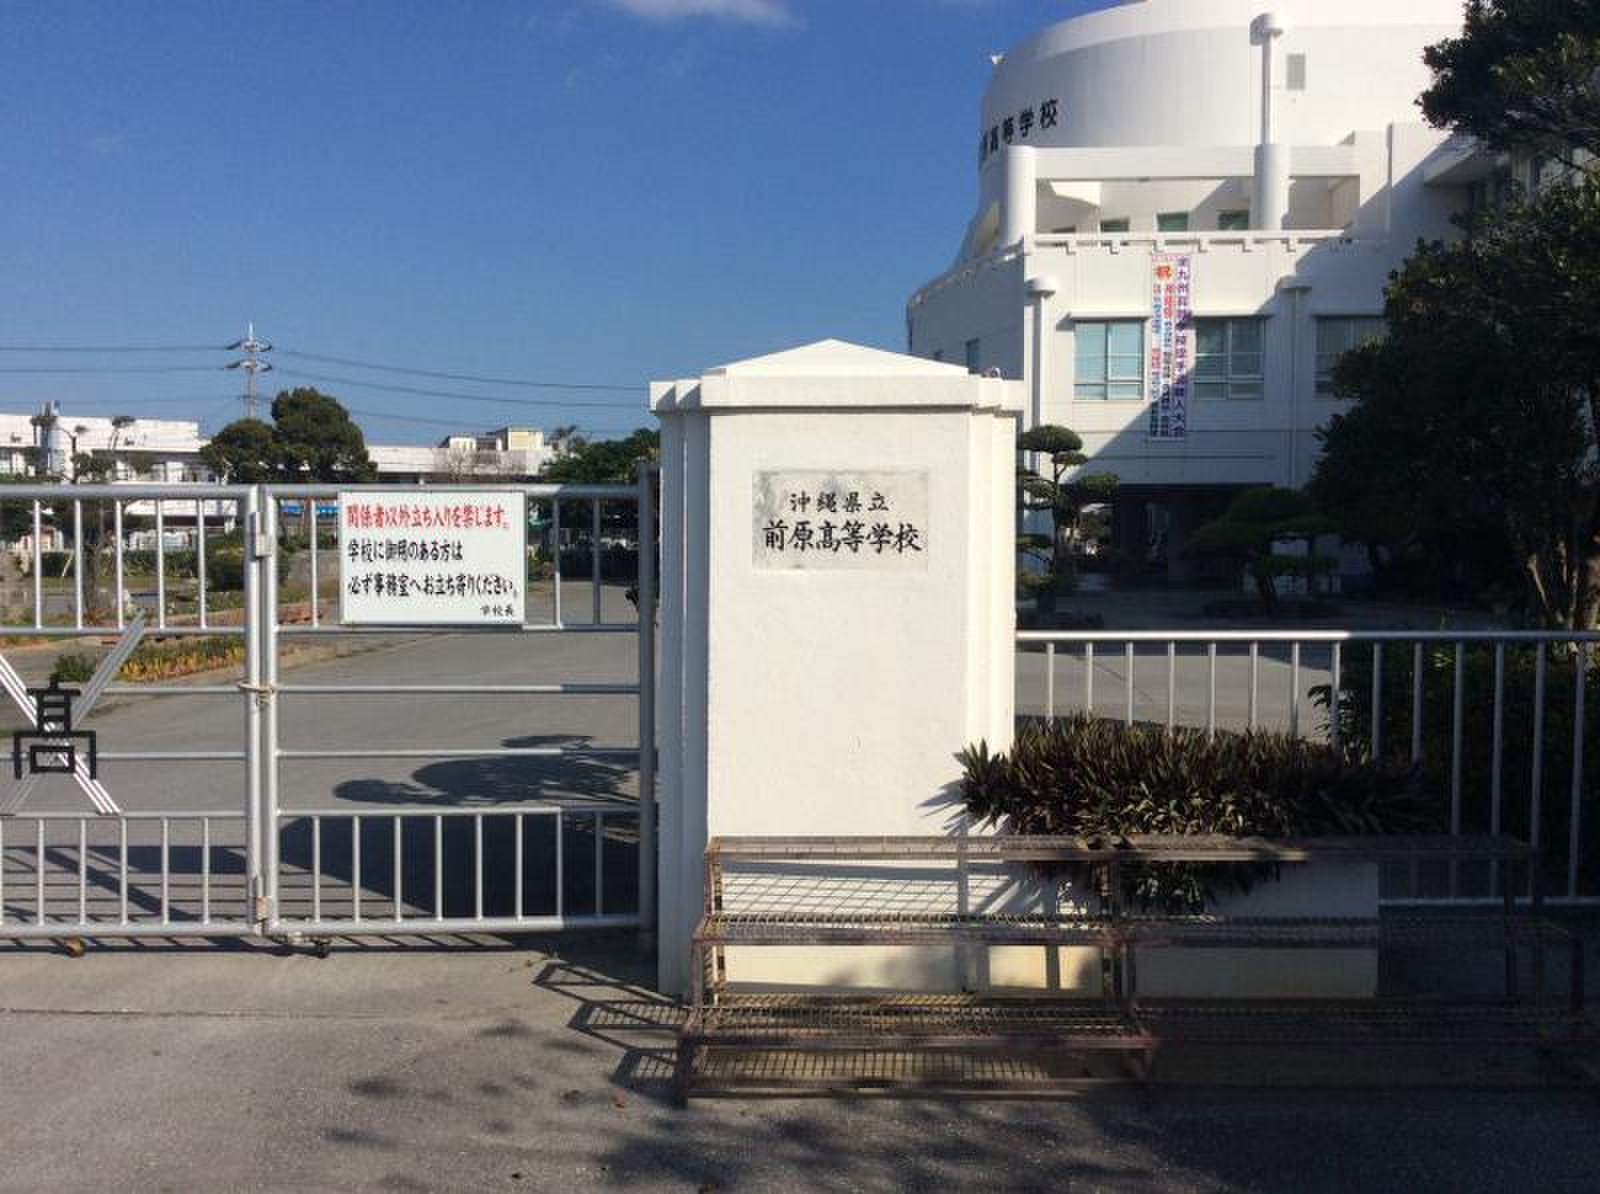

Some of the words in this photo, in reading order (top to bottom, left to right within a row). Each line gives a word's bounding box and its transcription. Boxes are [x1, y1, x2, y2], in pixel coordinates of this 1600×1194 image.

[790, 491, 890, 513] 沖縄県立
[348, 538, 464, 562] 学校に御用のある方は
